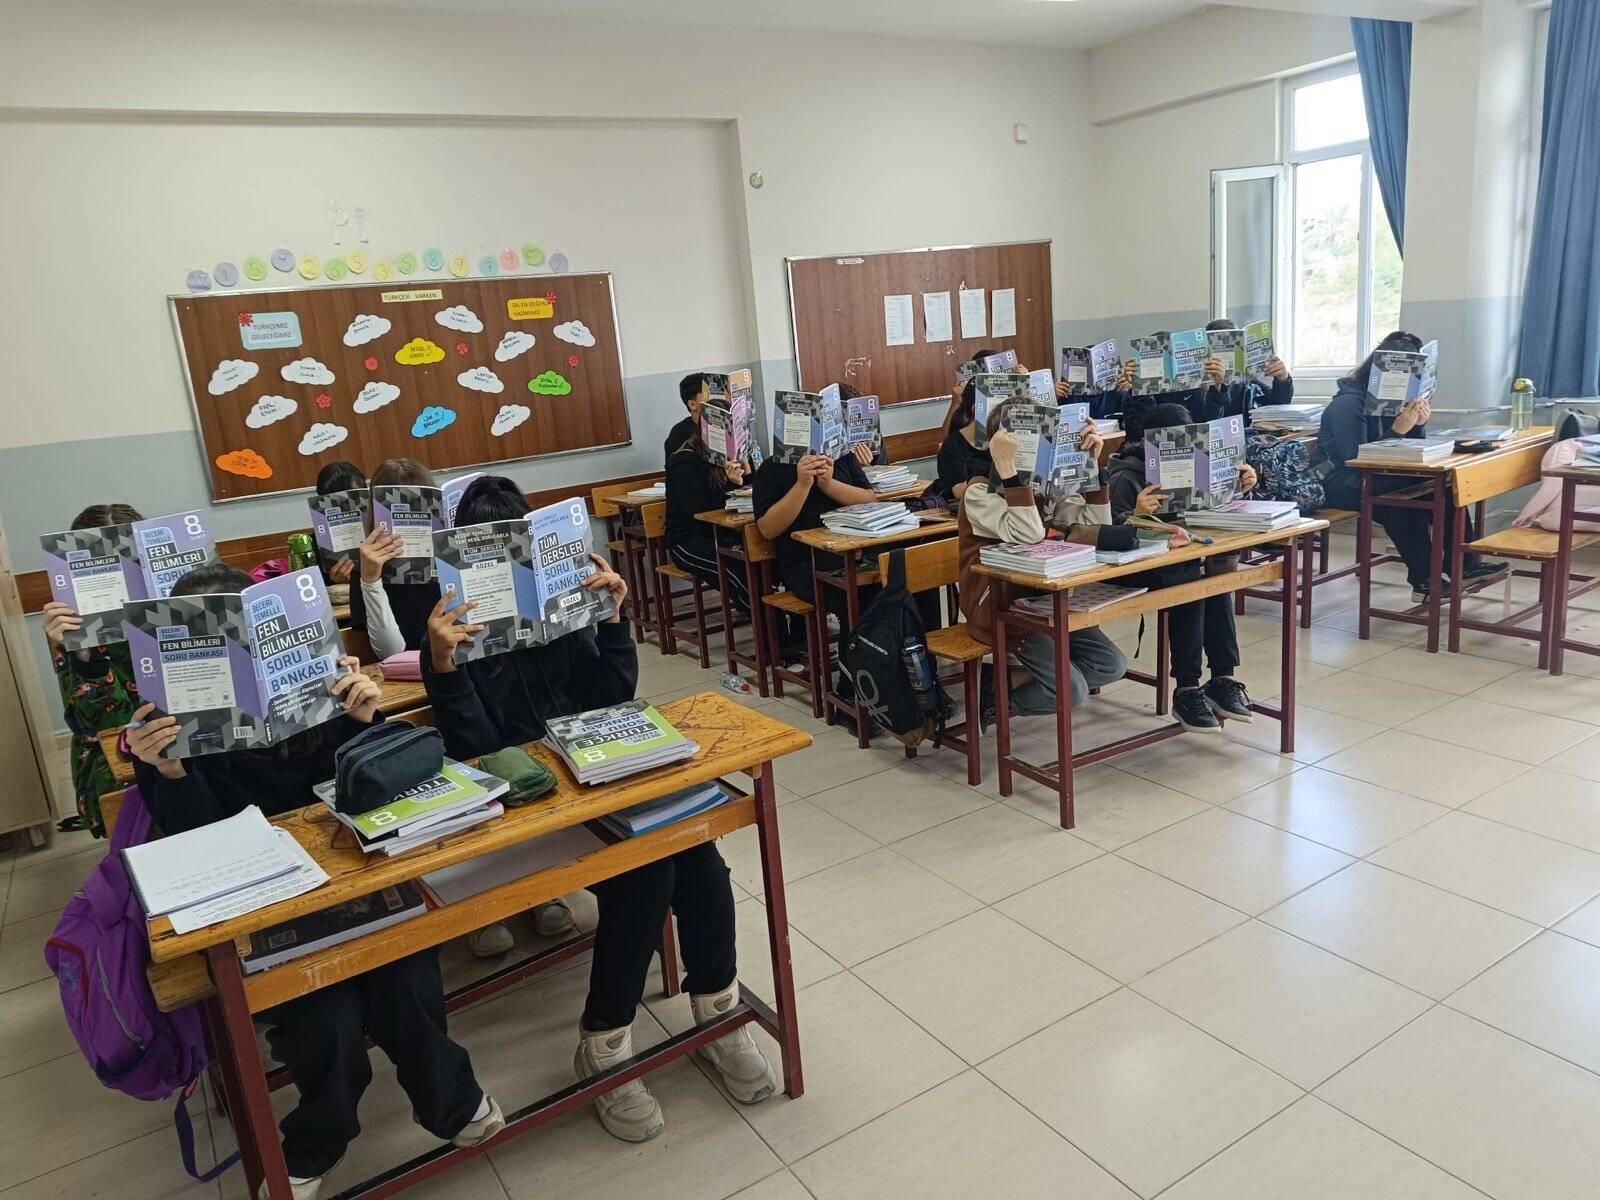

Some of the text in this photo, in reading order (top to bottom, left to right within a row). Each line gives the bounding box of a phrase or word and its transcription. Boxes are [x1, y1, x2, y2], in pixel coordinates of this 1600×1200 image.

[1195, 330, 1204, 342] 8
[868, 398, 875, 410] 8
[1230, 418, 1240, 434] 8
[570, 504, 584, 526] 8
[318, 525, 325, 534] 8
[149, 545, 170, 558] FEN
[539, 536, 558, 550] TÜM
[152, 552, 202, 571] BİLİMLERİ
[542, 542, 583, 566] DERSLER
[71, 557, 116, 570] FEN BİLİMLERİ
[544, 562, 570, 580] SORU
[158, 568, 186, 584] SORU
[548, 570, 588, 594] BANKASI
[258, 621, 280, 640] FEN
[182, 638, 220, 648] BİLİMLERİ
[262, 622, 320, 658] BİLİMLERİ
[164, 650, 223, 661] SORU BANKASI
[267, 651, 301, 674] SORU
[271, 660, 329, 693] BANKASI
[582, 713, 640, 732] BANKASI
[608, 720, 646, 732] SORU
[584, 725, 651, 746] TÜRKÇE
